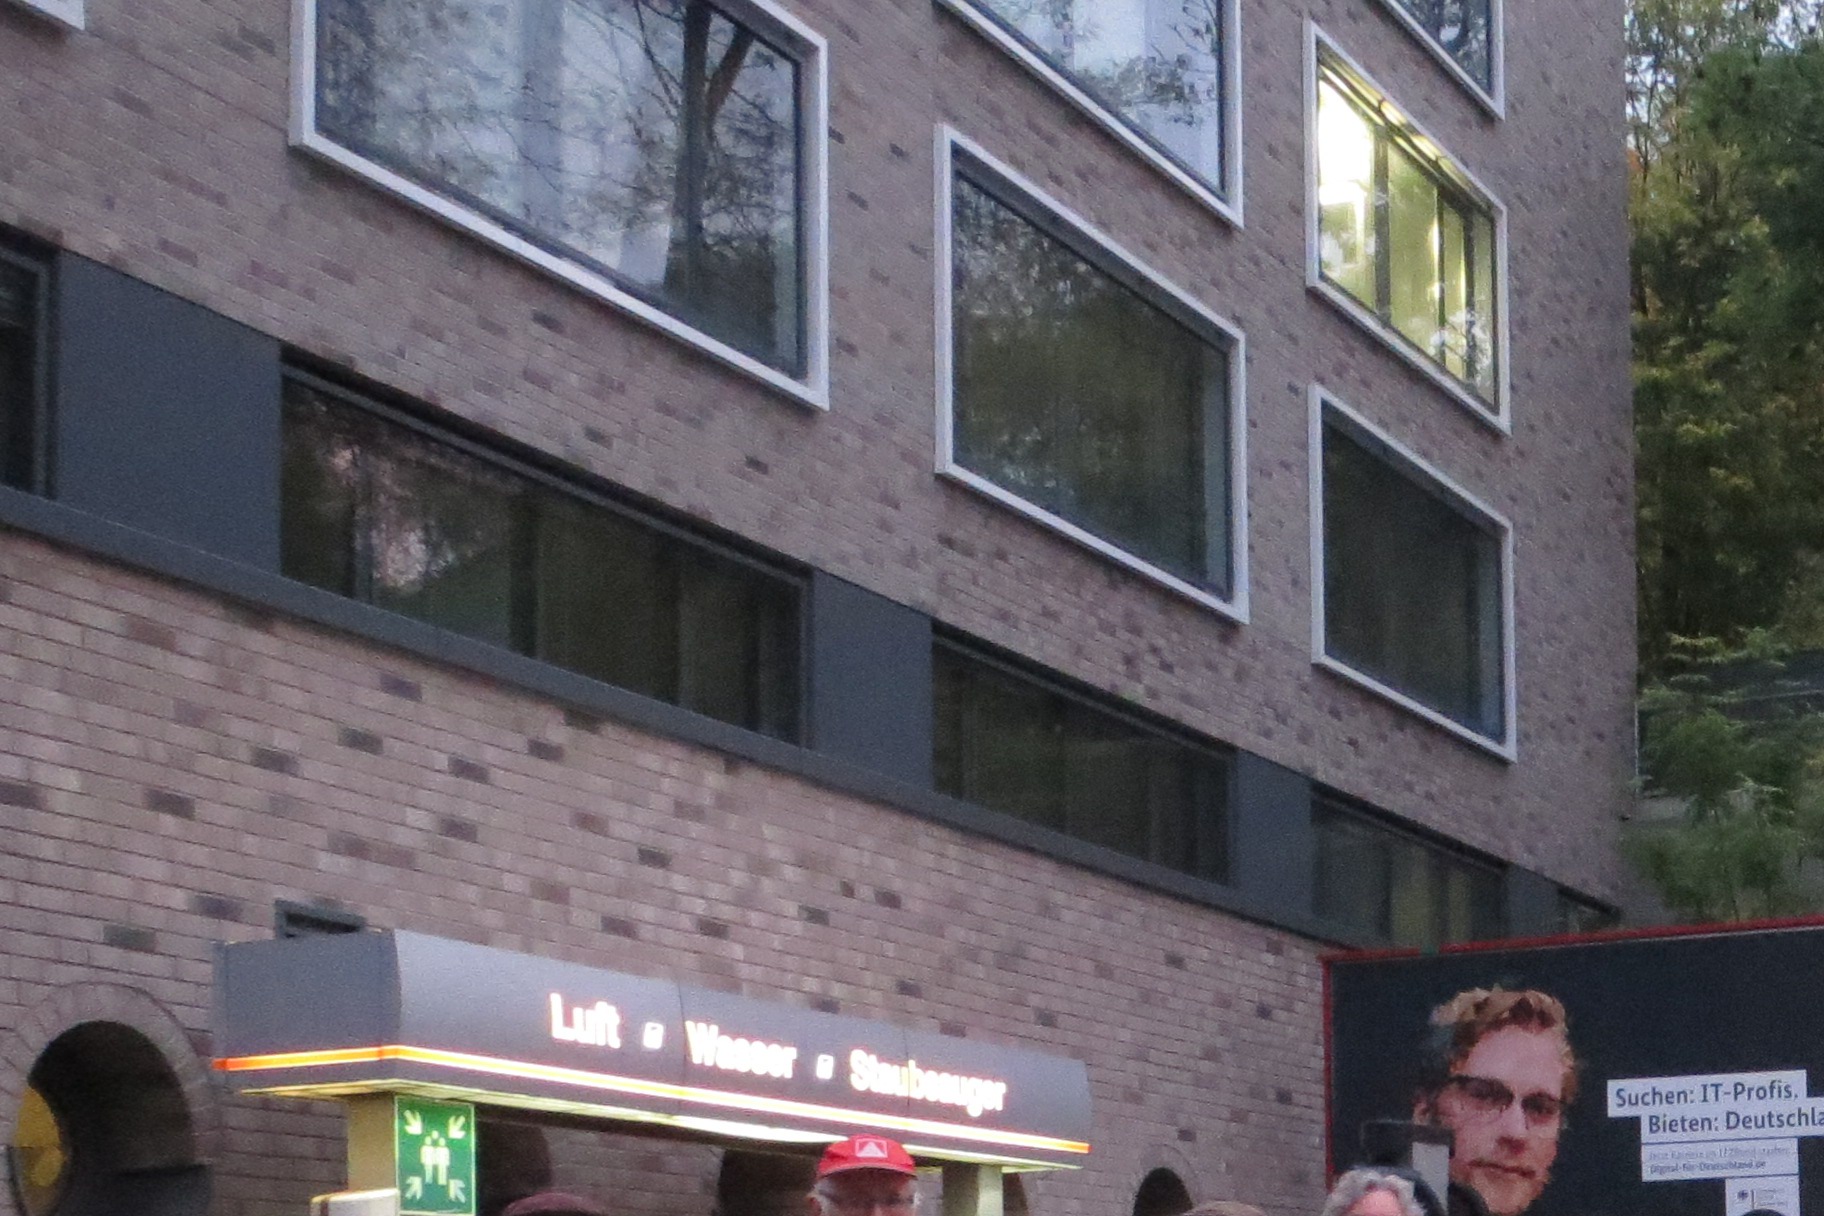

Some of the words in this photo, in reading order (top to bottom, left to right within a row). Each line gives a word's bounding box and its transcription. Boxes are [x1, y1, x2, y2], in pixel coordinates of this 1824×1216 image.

[550, 993, 620, 1048] Luft
[685, 1021, 797, 1079] Wasser
[1615, 1086, 1695, 1107] Suchen:
[1700, 1079, 1798, 1104] IT-Profis.
[1649, 1113, 1719, 1134] Bieten:
